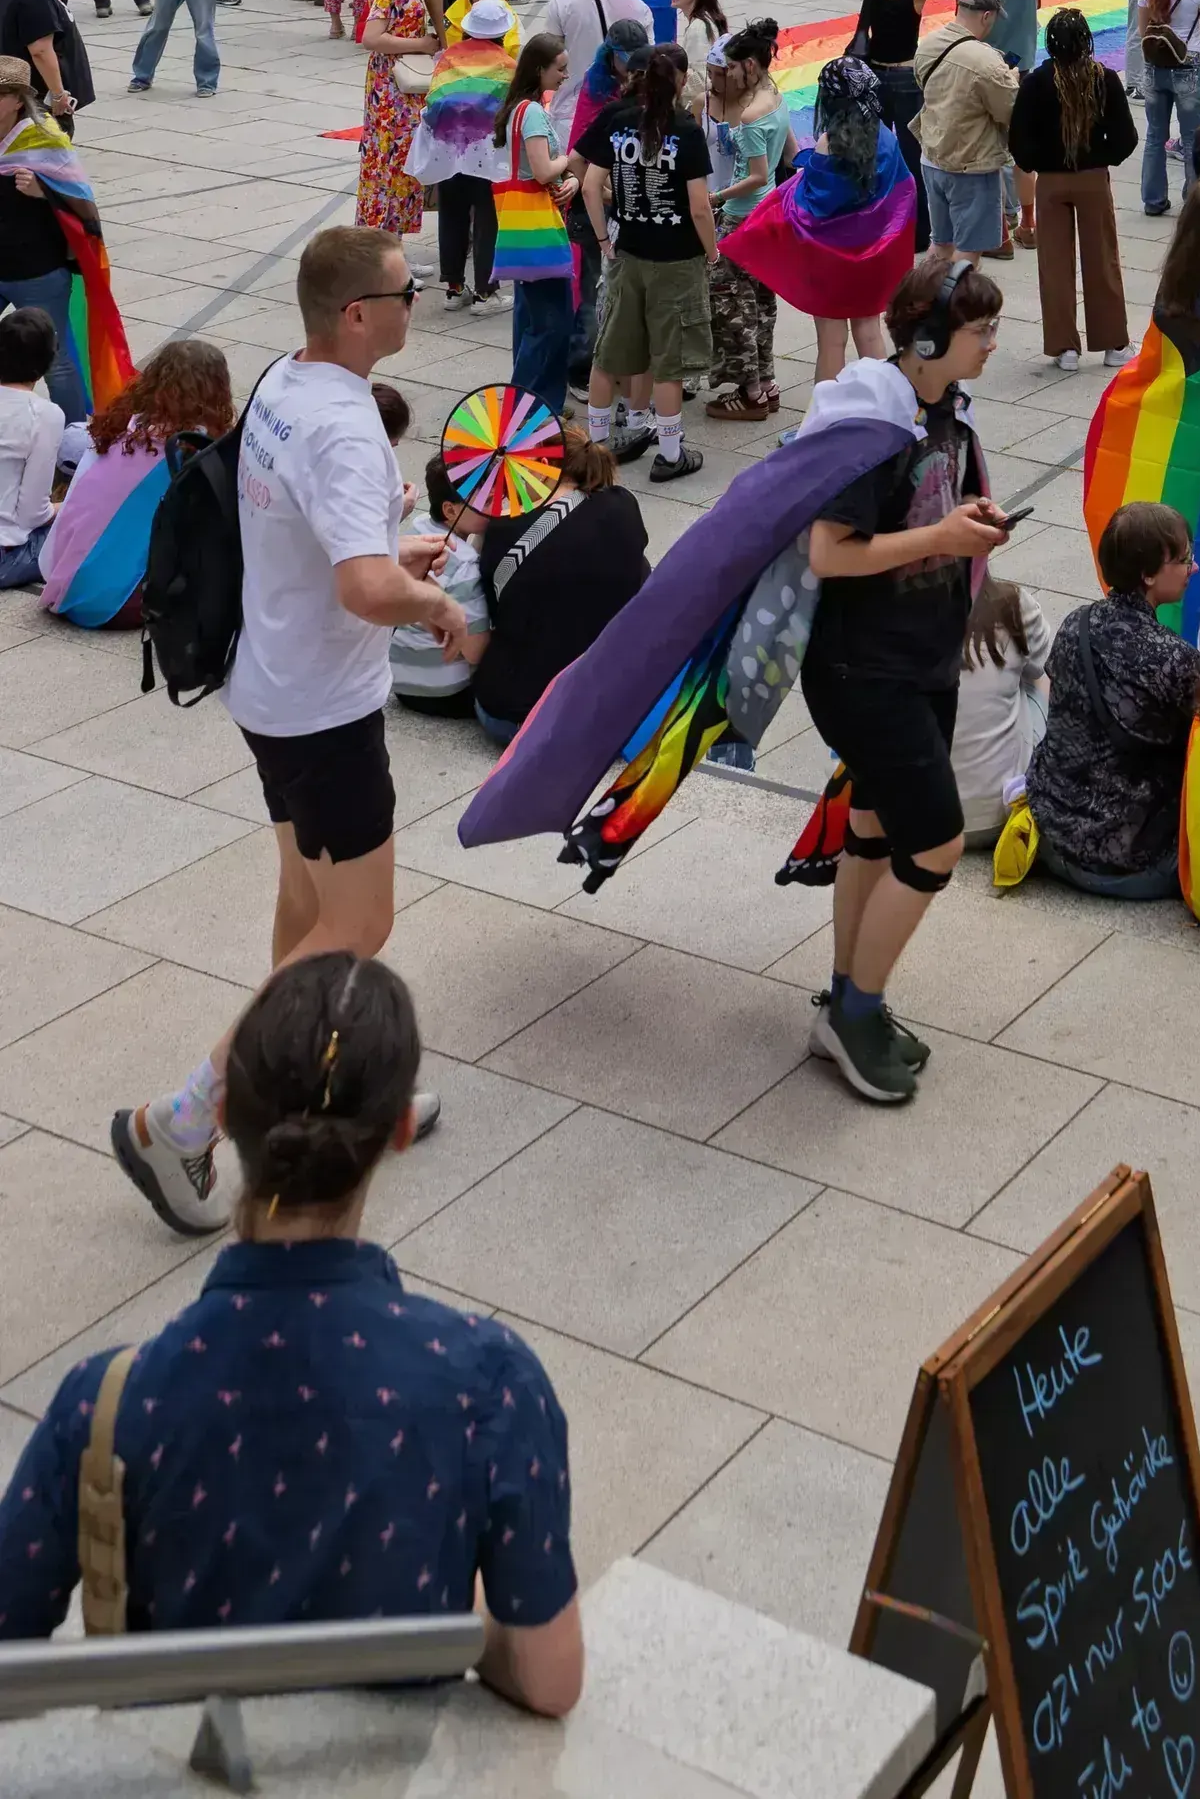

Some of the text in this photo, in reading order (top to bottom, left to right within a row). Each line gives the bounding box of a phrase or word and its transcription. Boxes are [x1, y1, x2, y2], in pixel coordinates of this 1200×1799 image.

[1013, 1324, 1102, 1438] Heute
[1010, 1455, 1086, 1556] alle
[1091, 1425, 1173, 1575] Getränke
[1084, 1605, 1123, 1684] nur
